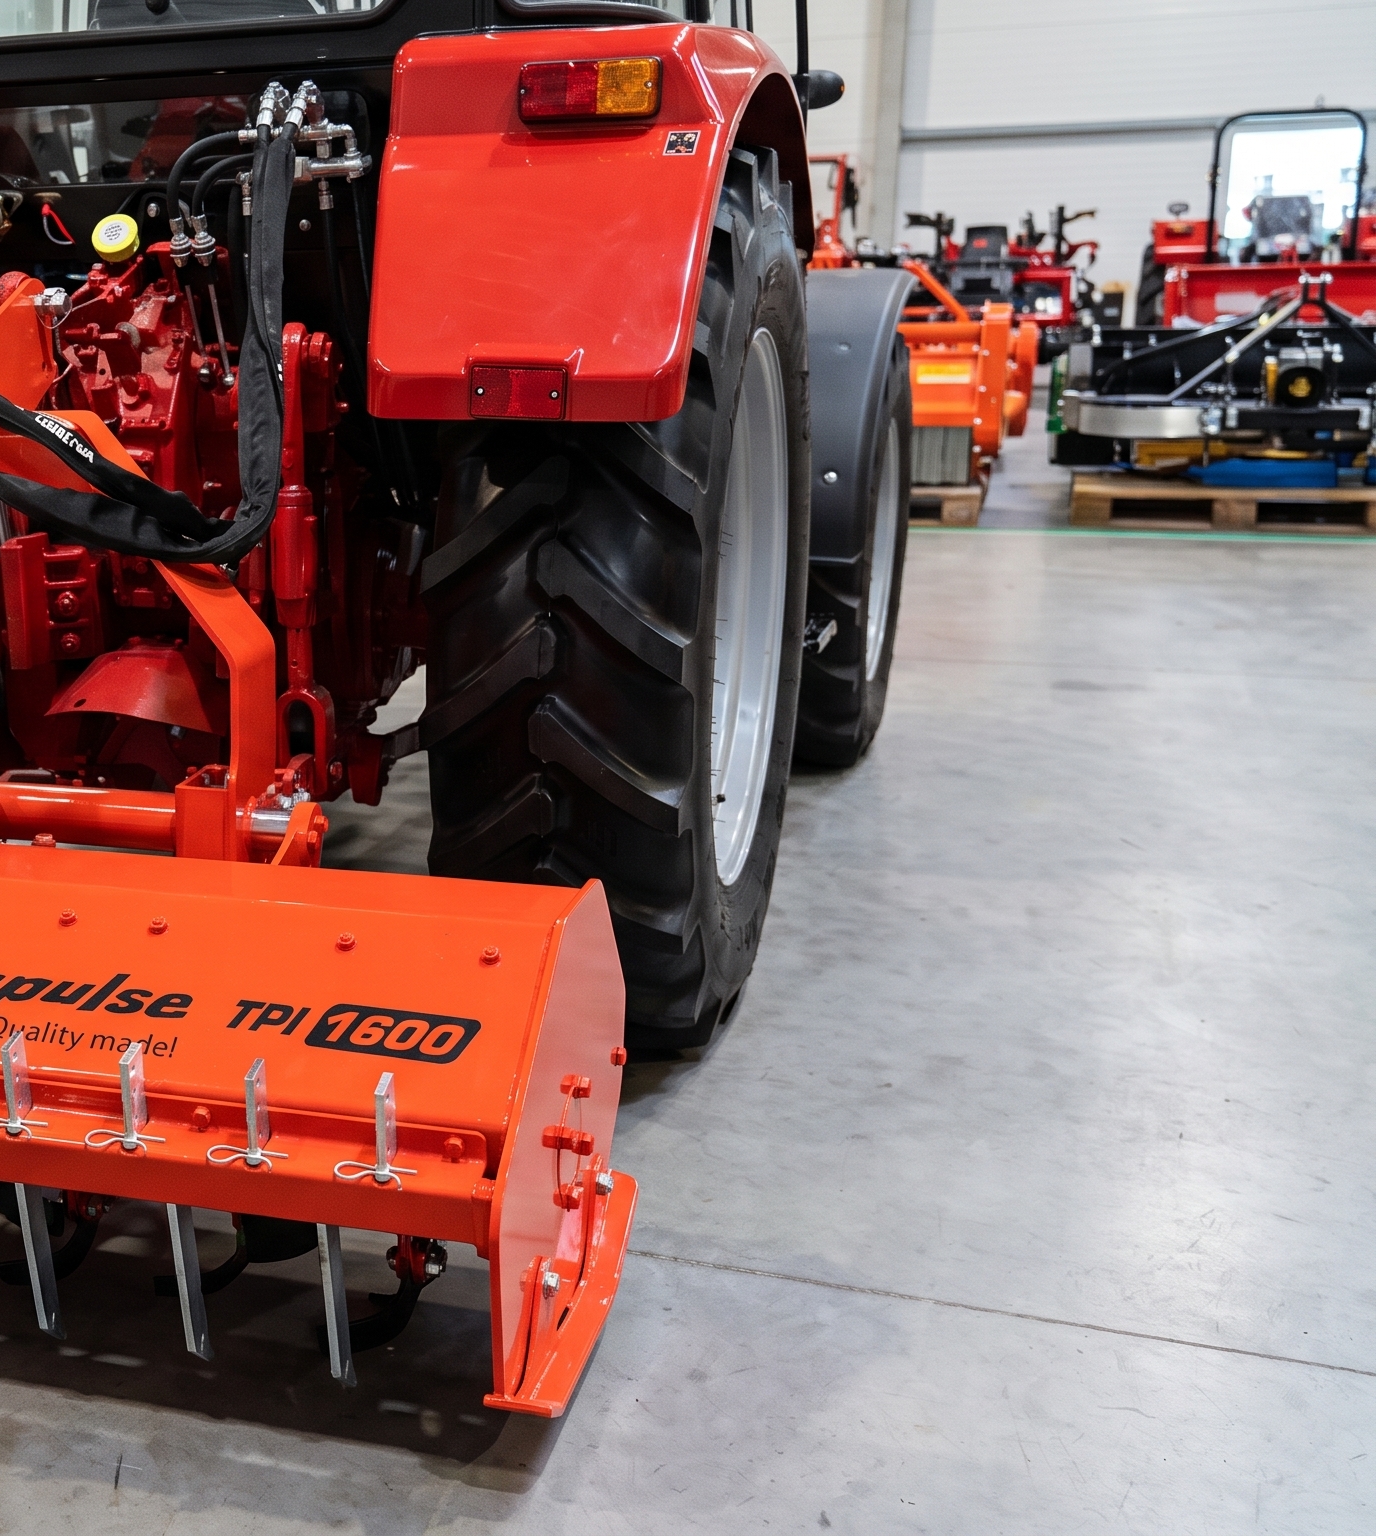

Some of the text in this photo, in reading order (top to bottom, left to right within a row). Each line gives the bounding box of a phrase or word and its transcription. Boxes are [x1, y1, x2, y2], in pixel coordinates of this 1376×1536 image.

[90, 1033, 178, 1058] made!
[226, 999, 466, 1056] TPI 1600
